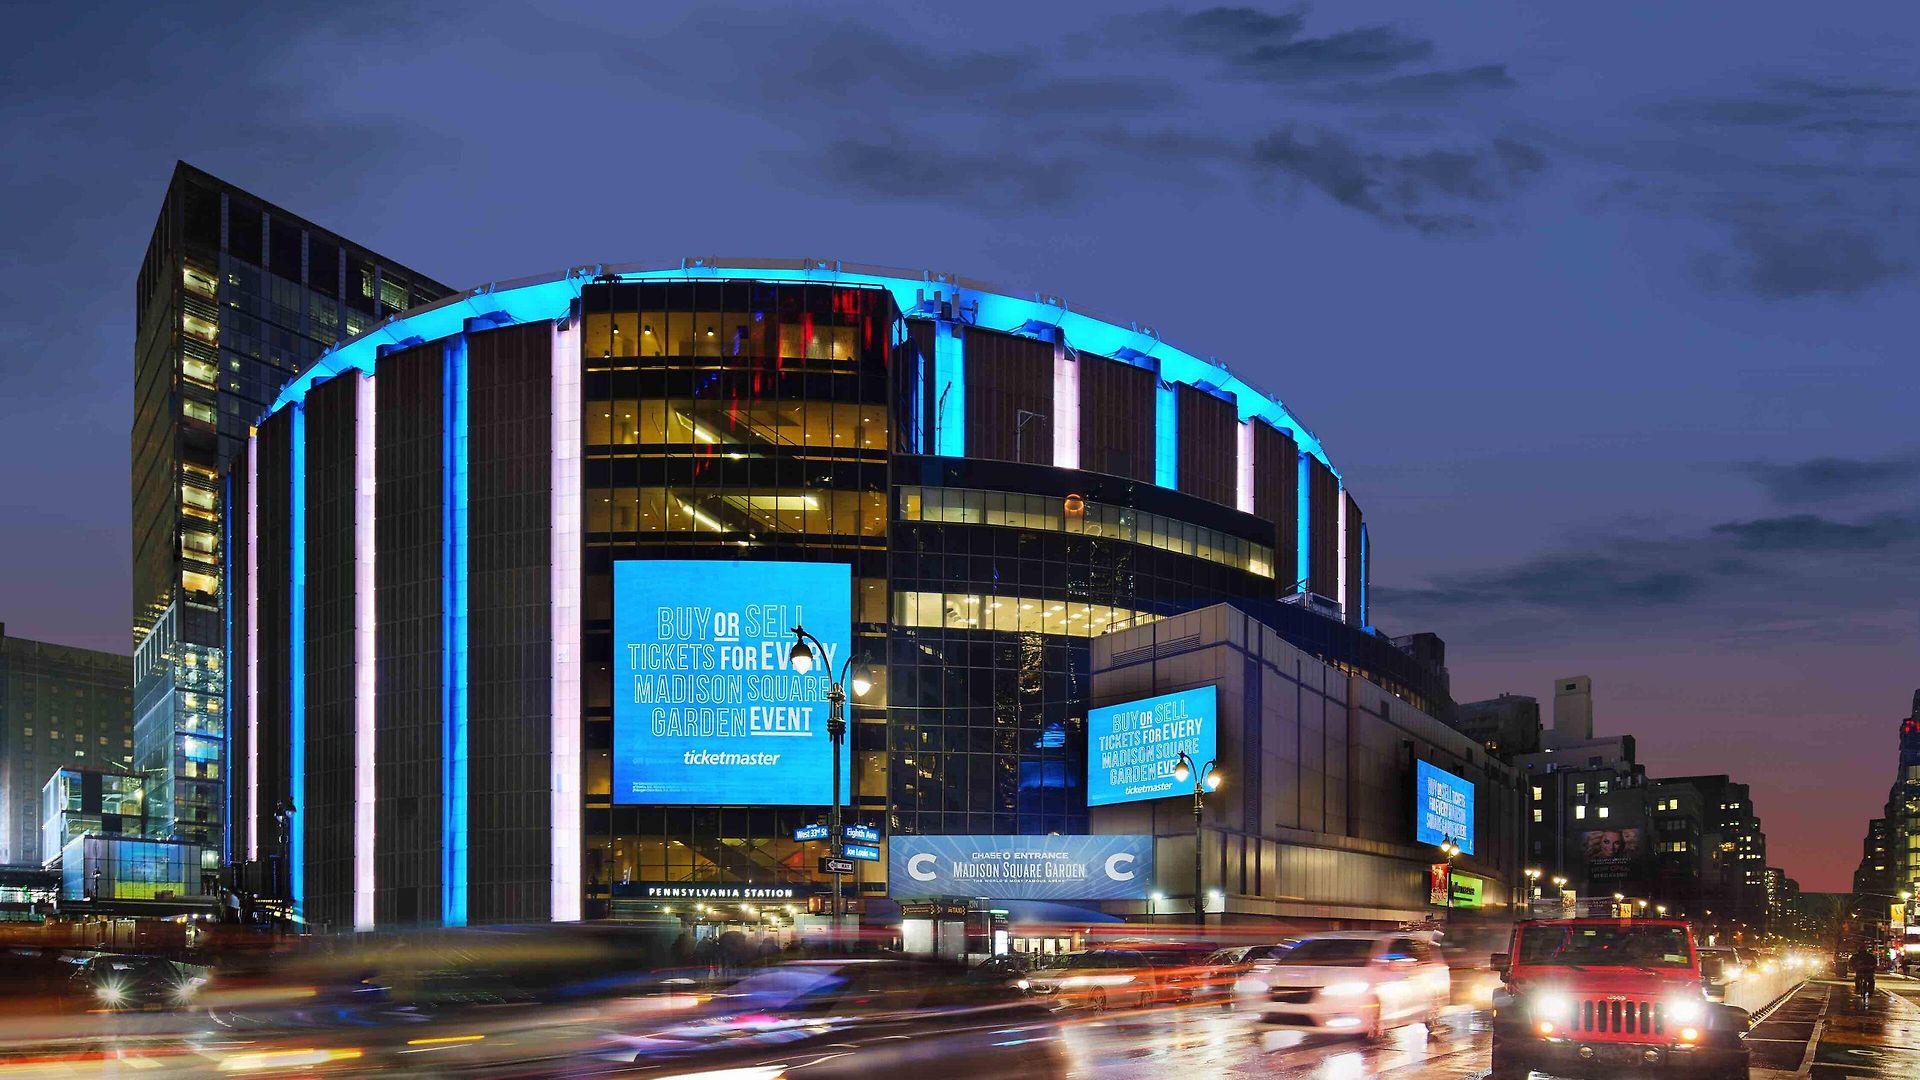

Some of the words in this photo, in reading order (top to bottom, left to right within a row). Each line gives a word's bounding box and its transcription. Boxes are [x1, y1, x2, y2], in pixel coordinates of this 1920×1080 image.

[657, 606, 711, 640] BUY
[714, 612, 740, 637] OR
[628, 643, 715, 670] TICKETS
[720, 646, 757, 671] FOR
[761, 641, 838, 671] EVRY
[634, 674, 743, 704] MADISON
[747, 674, 830, 702] SQUARE
[651, 707, 746, 737] GARDEN
[750, 706, 813, 731] EVENT
[1112, 710, 1140, 733] BUY
[1140, 711, 1152, 727] OR
[1155, 699, 1189, 724] SELL
[1098, 730, 1141, 752] TICKETS
[1143, 727, 1162, 745] FOR
[1163, 717, 1203, 741] EVERY
[683, 749, 781, 766] ticketmaster
[1101, 745, 1155, 769] MADISON
[1156, 738, 1200, 760] SQUARE
[1109, 764, 1157, 786] GARDEN
[1125, 782, 1174, 795] ticketmaster
[797, 830, 810, 839] West
[821, 828, 828, 836] St
[846, 827, 865, 839] Eighth
[865, 831, 877, 840] Ave
[846, 847, 856, 856] Joe
[972, 852, 1002, 860] CHASE
[1014, 852, 1069, 860] ENTRANCE
[953, 861, 1000, 878] MADISON
[1003, 861, 1042, 879] SQUARE
[1045, 861, 1085, 878] GARDEN
[648, 887, 740, 897] PENNSYLVANIA
[744, 888, 793, 898] STATION
